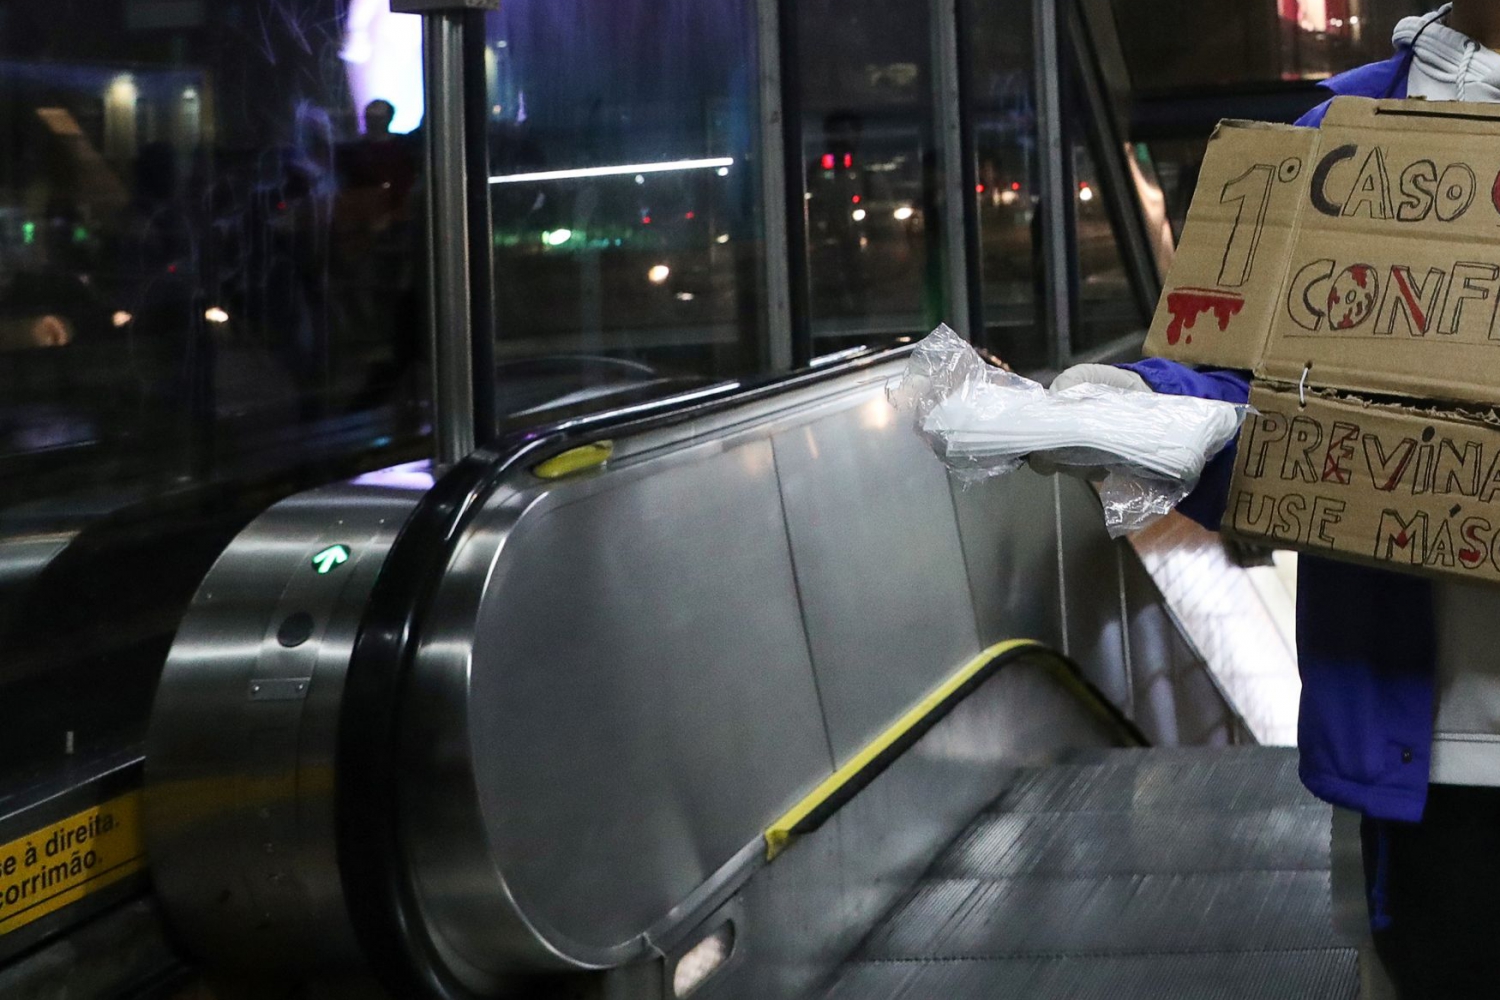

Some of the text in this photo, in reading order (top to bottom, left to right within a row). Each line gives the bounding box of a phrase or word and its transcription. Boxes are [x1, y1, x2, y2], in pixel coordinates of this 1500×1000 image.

[1310, 144, 1477, 222] CASO
[1233, 490, 1347, 549] USE
[25, 841, 37, 867] à
